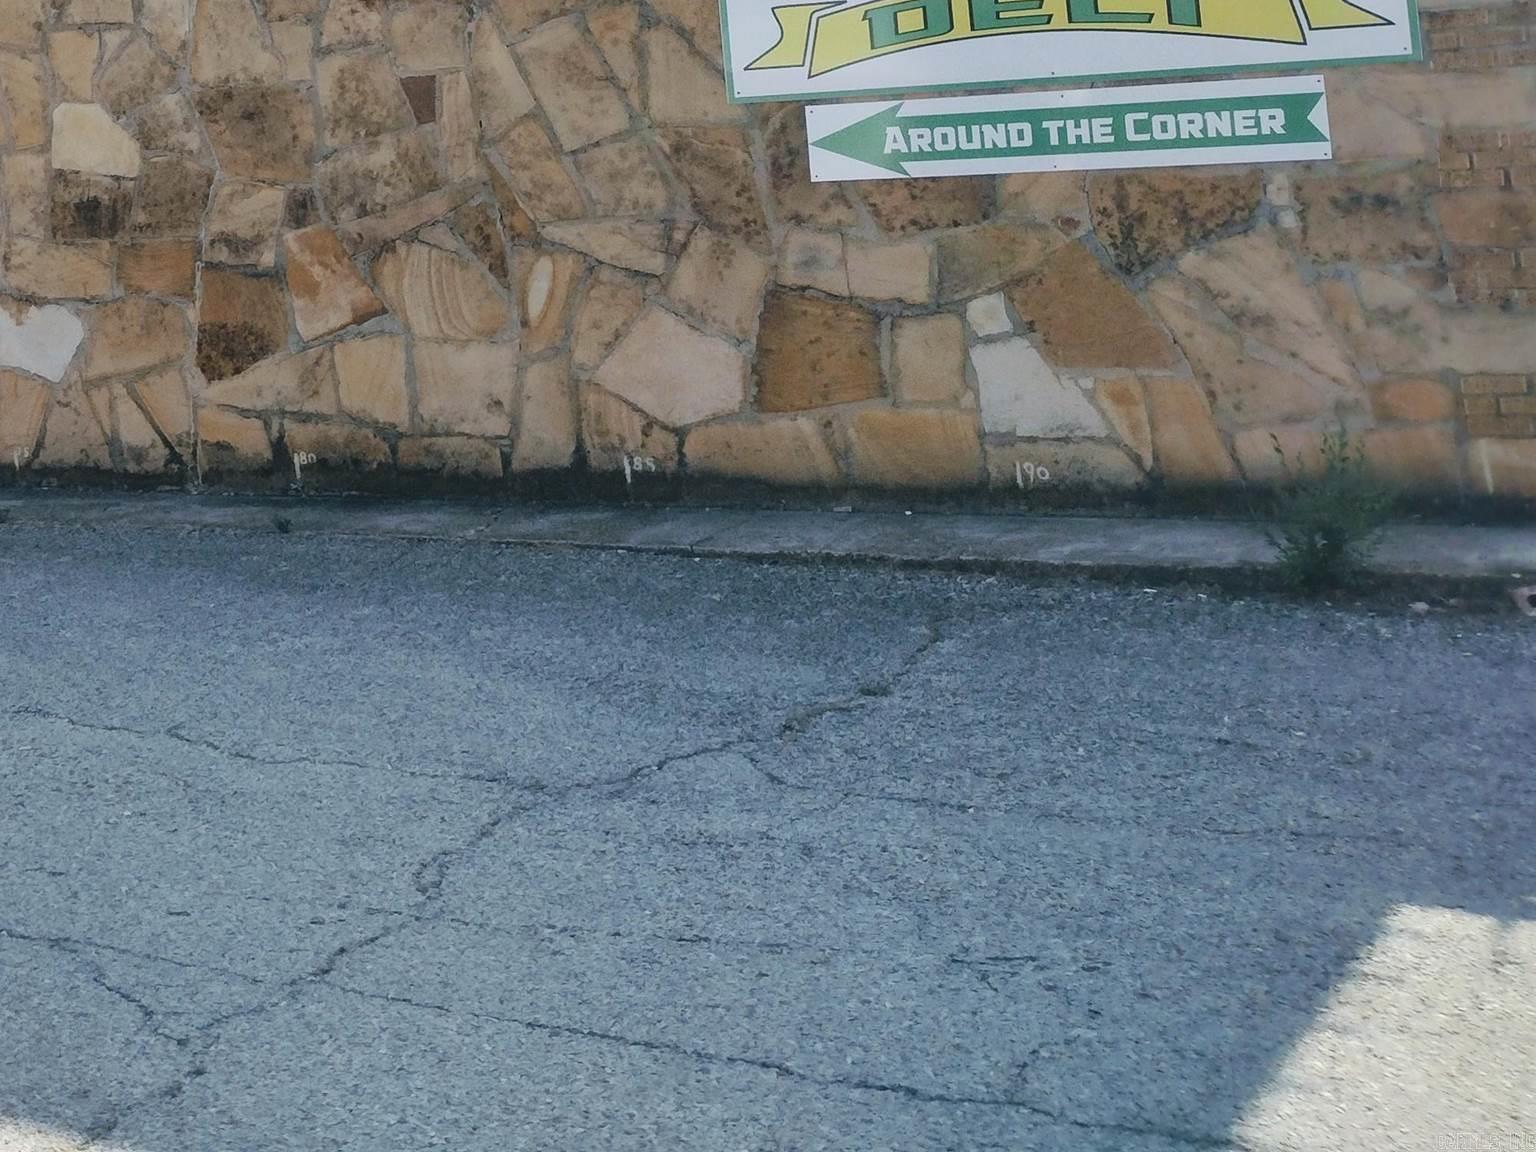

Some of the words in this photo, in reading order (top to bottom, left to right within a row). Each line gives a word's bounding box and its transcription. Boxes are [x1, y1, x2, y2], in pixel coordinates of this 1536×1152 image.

[883, 123, 1033, 154] AROUND
[1042, 117, 1115, 146] THE
[1124, 108, 1286, 141] CORNER
